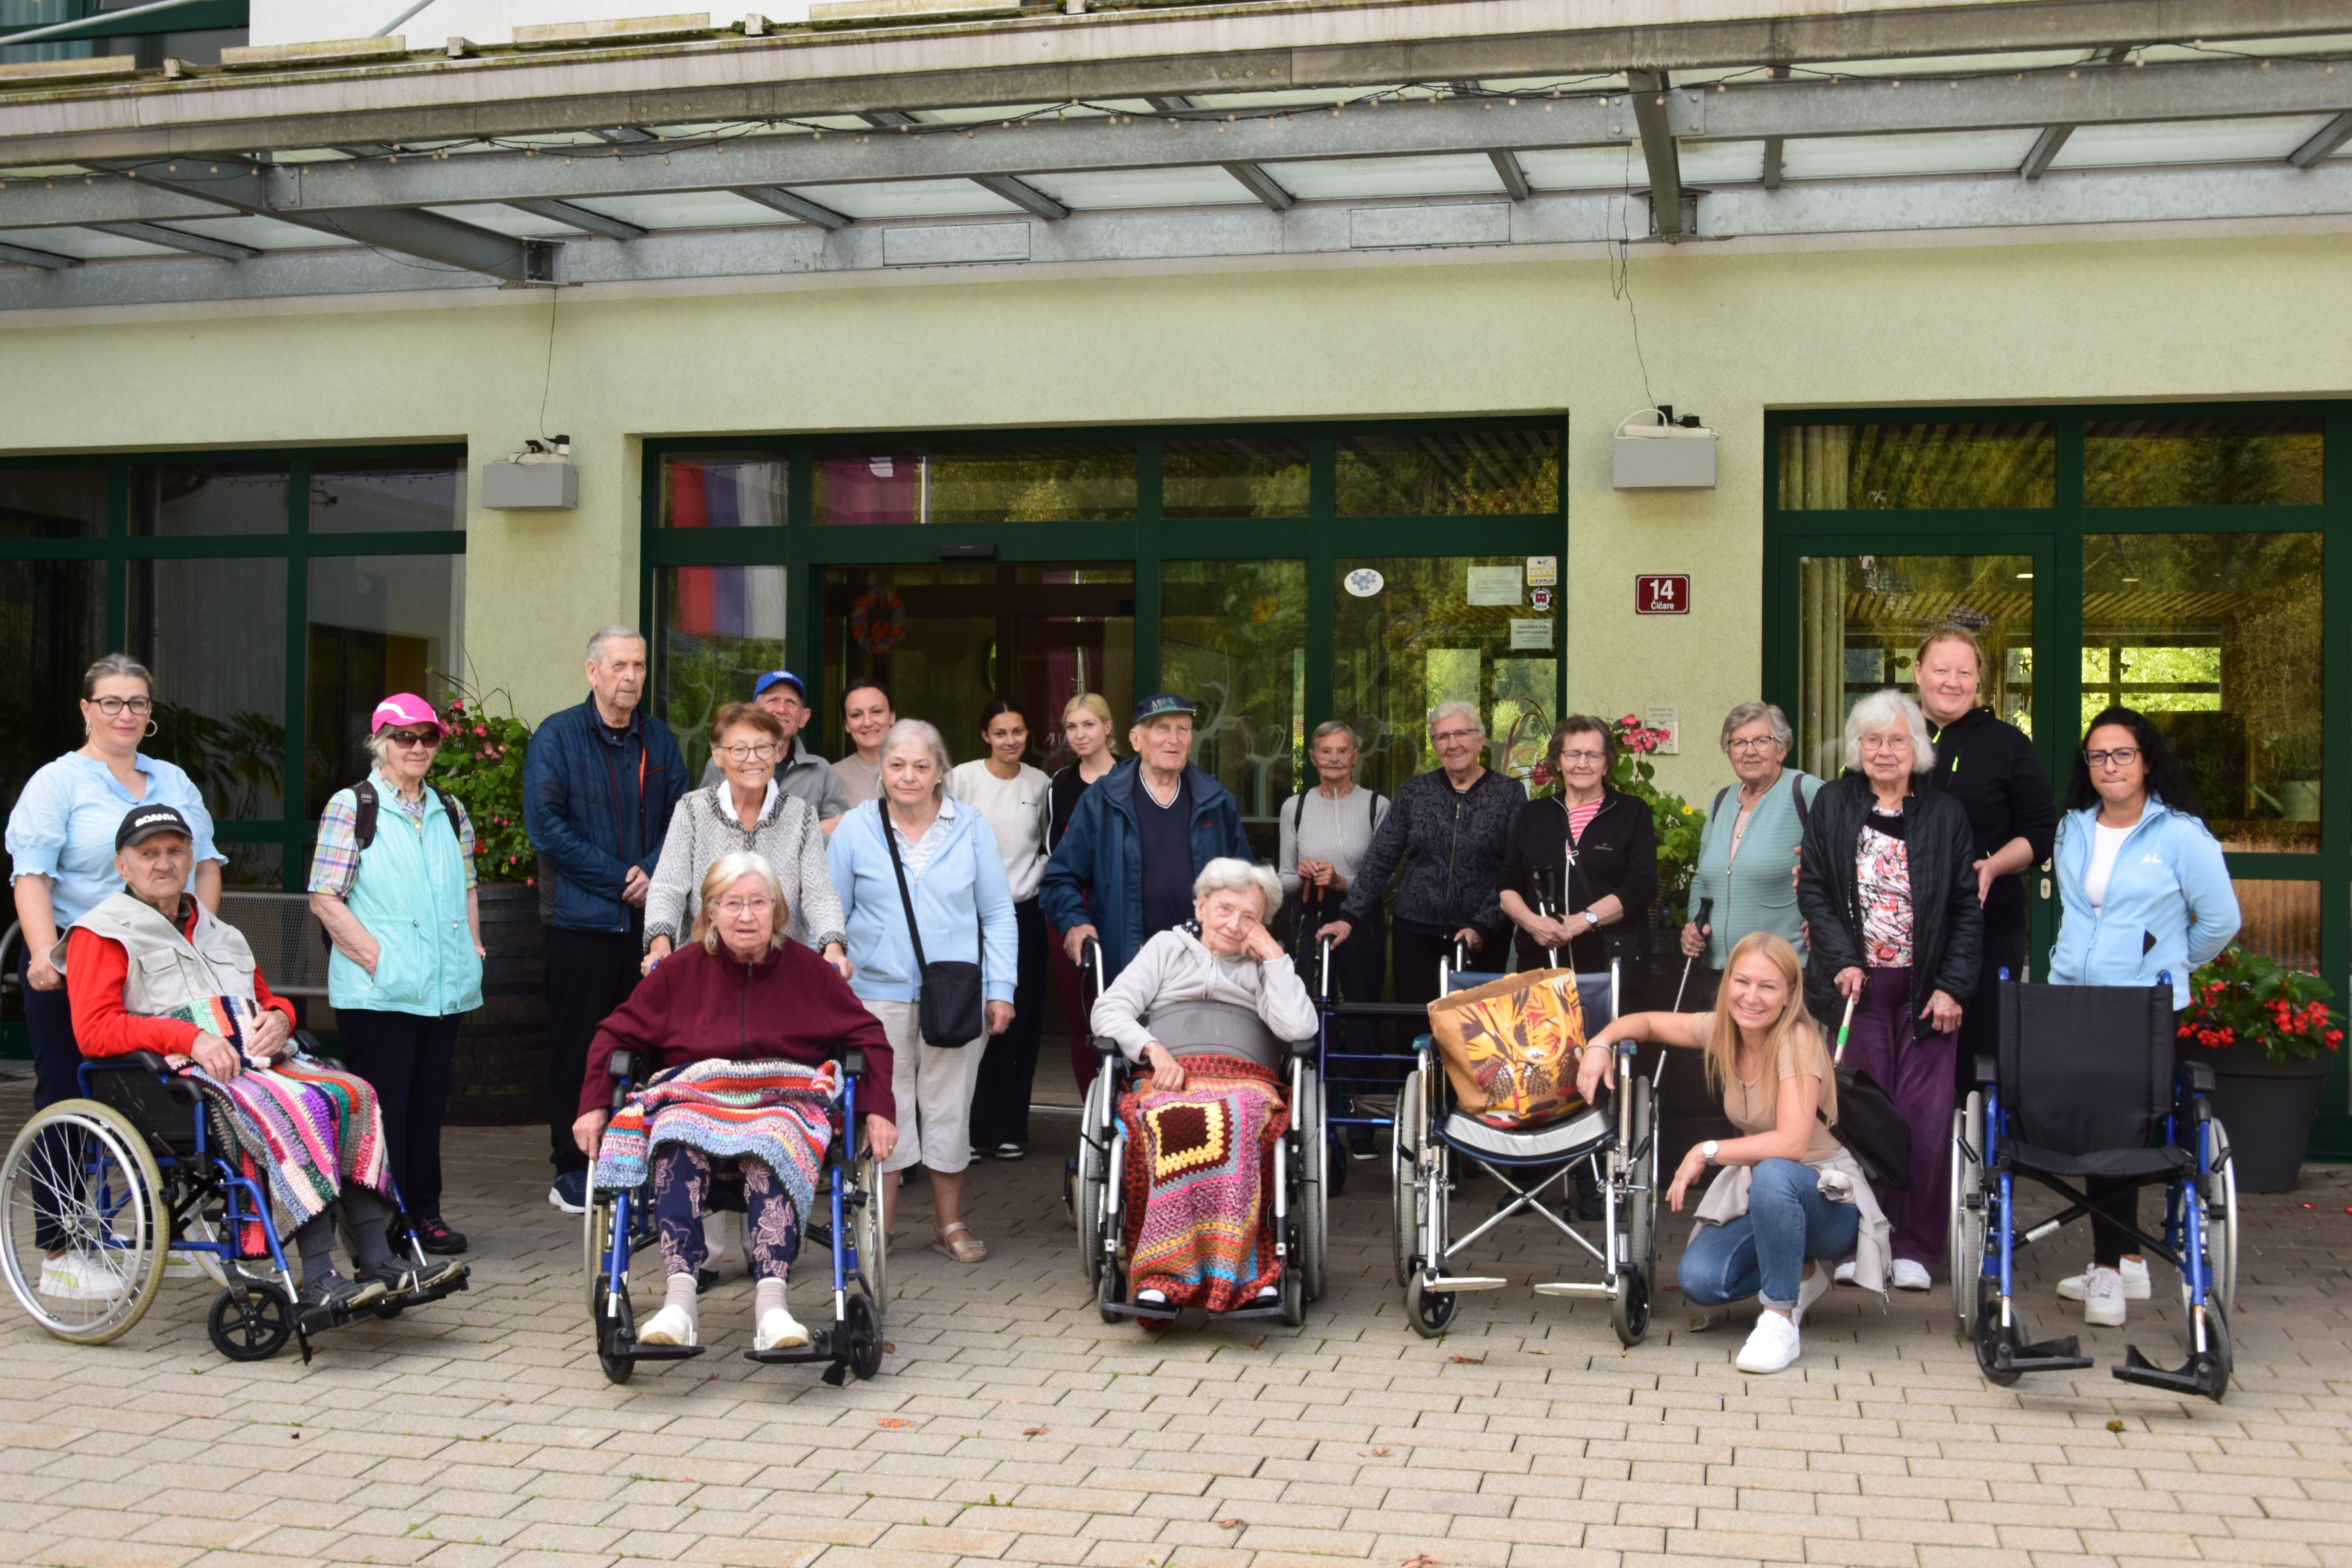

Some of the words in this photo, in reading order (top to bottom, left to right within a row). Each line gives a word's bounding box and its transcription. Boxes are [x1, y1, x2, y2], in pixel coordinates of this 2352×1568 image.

[1650, 579, 1674, 600] 14
[1651, 600, 1674, 610] Čičare
[135, 813, 178, 827] SCANIA
